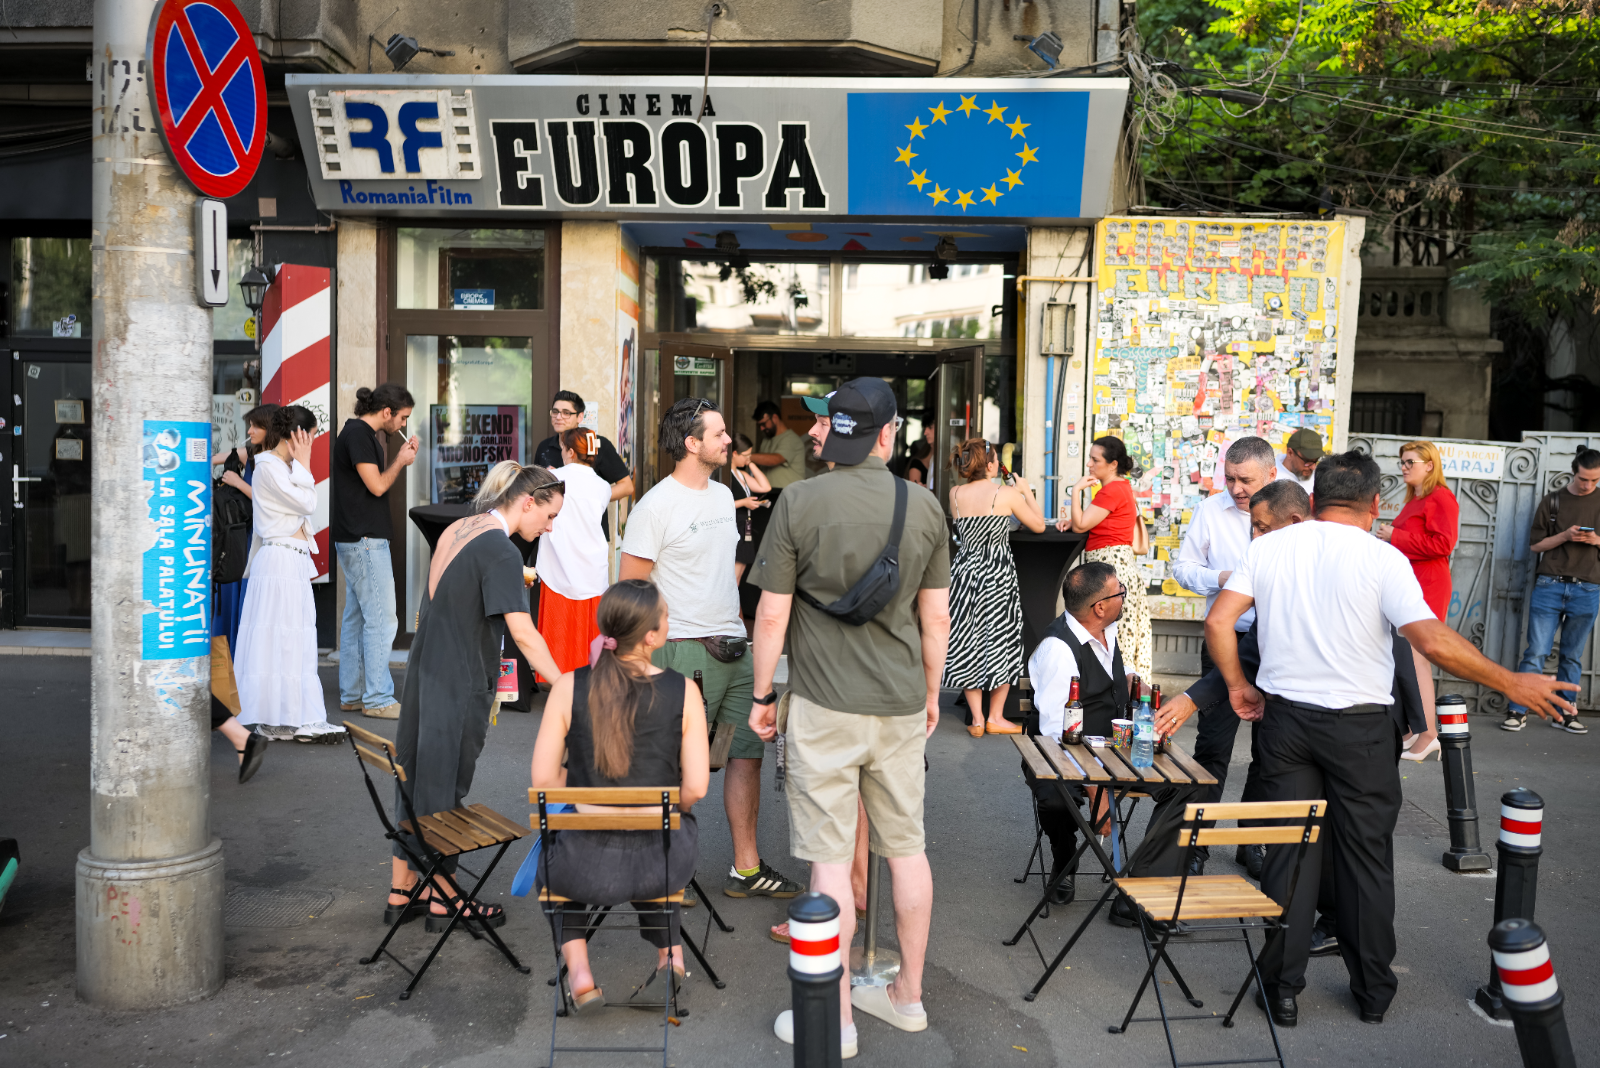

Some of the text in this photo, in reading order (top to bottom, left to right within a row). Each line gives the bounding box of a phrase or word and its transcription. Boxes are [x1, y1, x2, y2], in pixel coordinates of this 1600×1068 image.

[576, 94, 716, 116] CINEMA
[489, 117, 829, 211] EUROPA
[339, 179, 473, 206] RomaniaFilm
[480, 435, 513, 446] GARLAND
[1438, 445, 1500, 461] NU PARCATI
[158, 477, 175, 649] LA SALA PALATULUI
